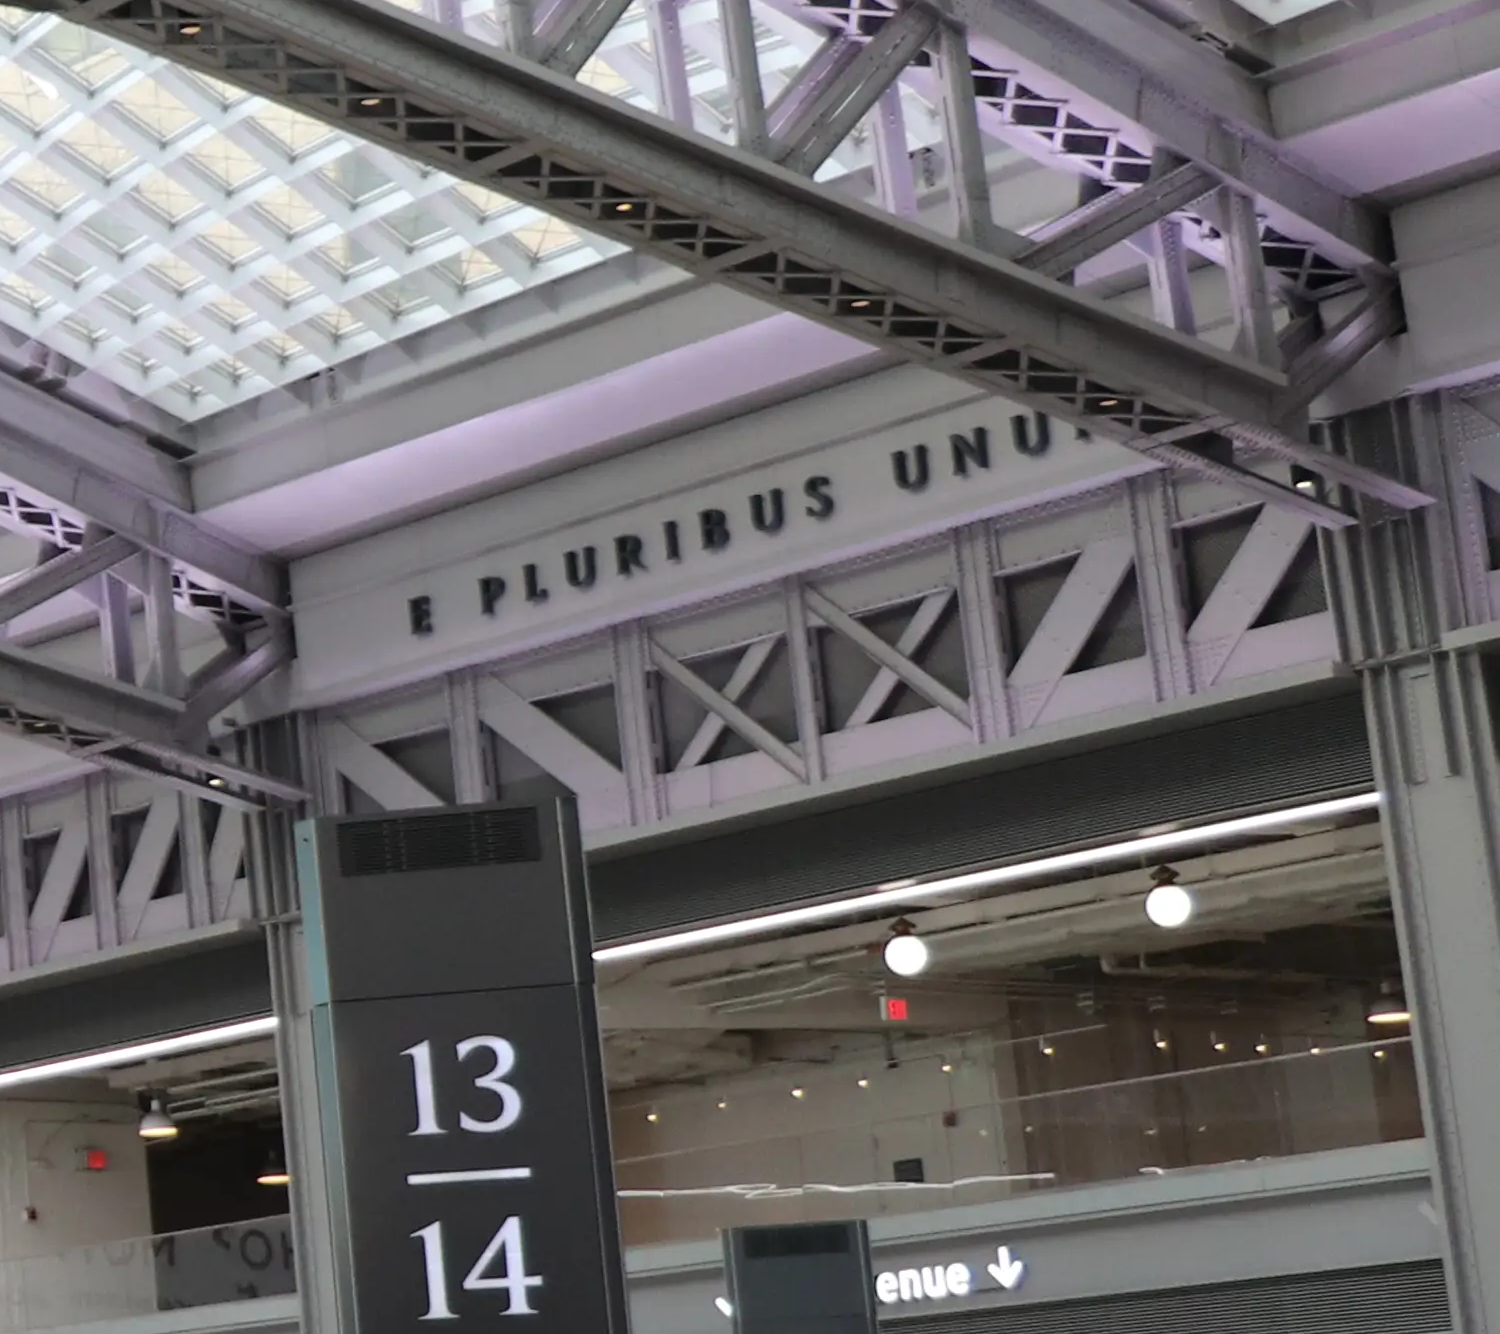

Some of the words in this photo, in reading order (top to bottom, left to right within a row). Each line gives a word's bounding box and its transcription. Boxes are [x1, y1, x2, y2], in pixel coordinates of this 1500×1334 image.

[408, 596, 434, 635] E
[478, 475, 835, 617] PLURIBUS
[891, 411, 1094, 492] UNU
[400, 1035, 523, 1136] 13
[409, 1215, 544, 1320] 14
[875, 1262, 971, 1304] enue
